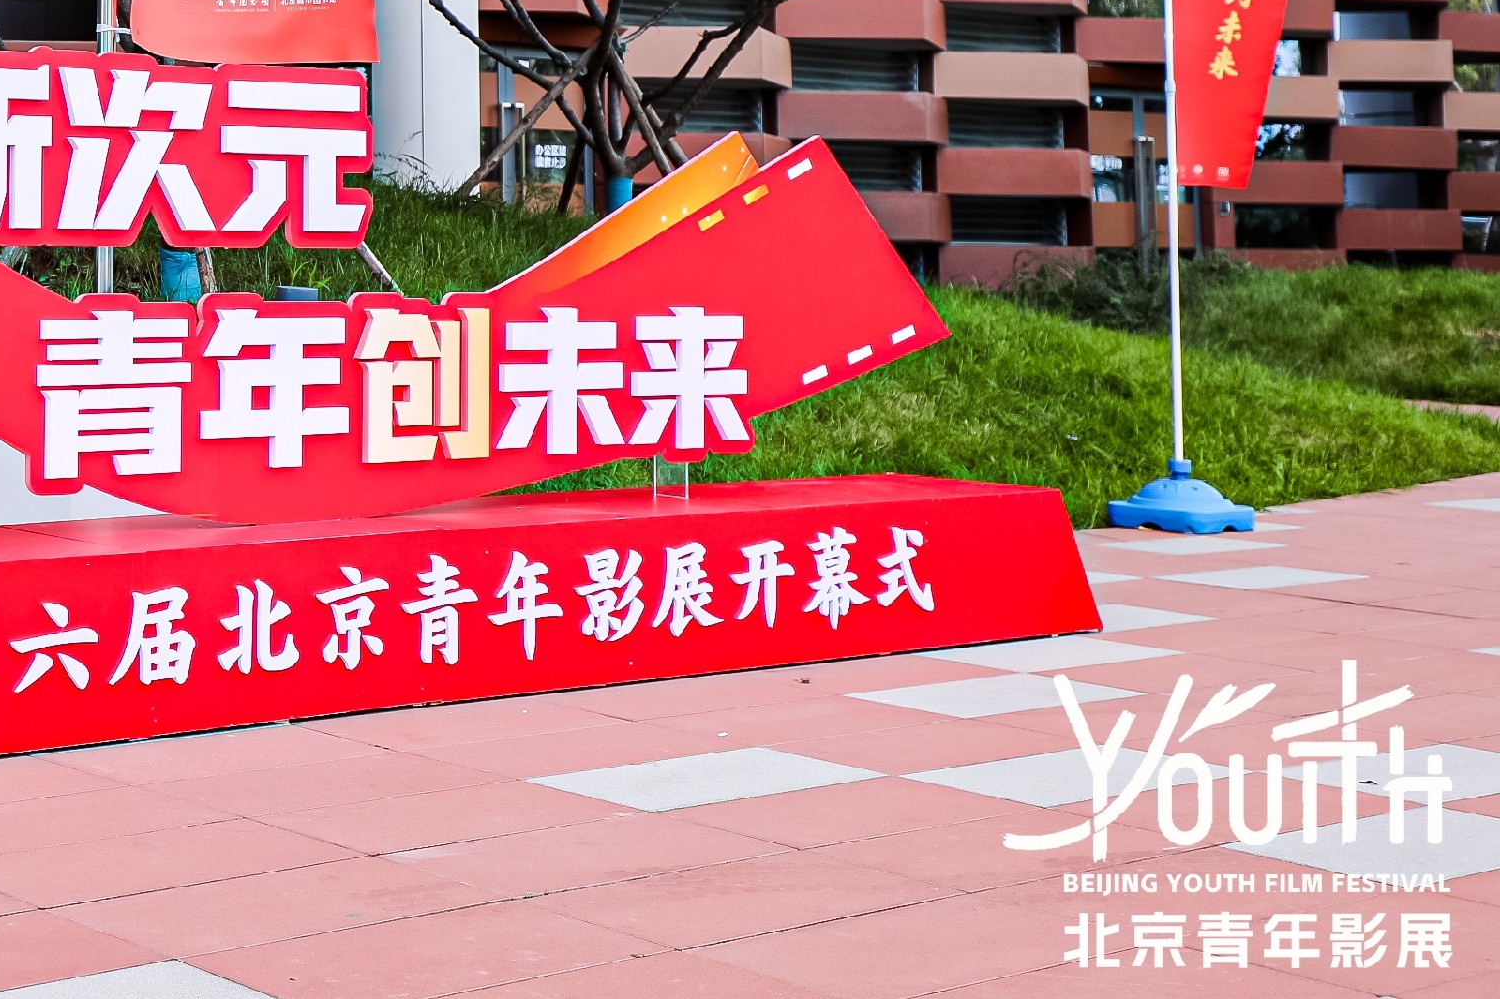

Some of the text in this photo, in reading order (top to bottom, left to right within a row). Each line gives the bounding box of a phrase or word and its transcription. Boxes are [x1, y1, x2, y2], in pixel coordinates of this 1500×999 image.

[35, 305, 750, 480] 青年创未来
